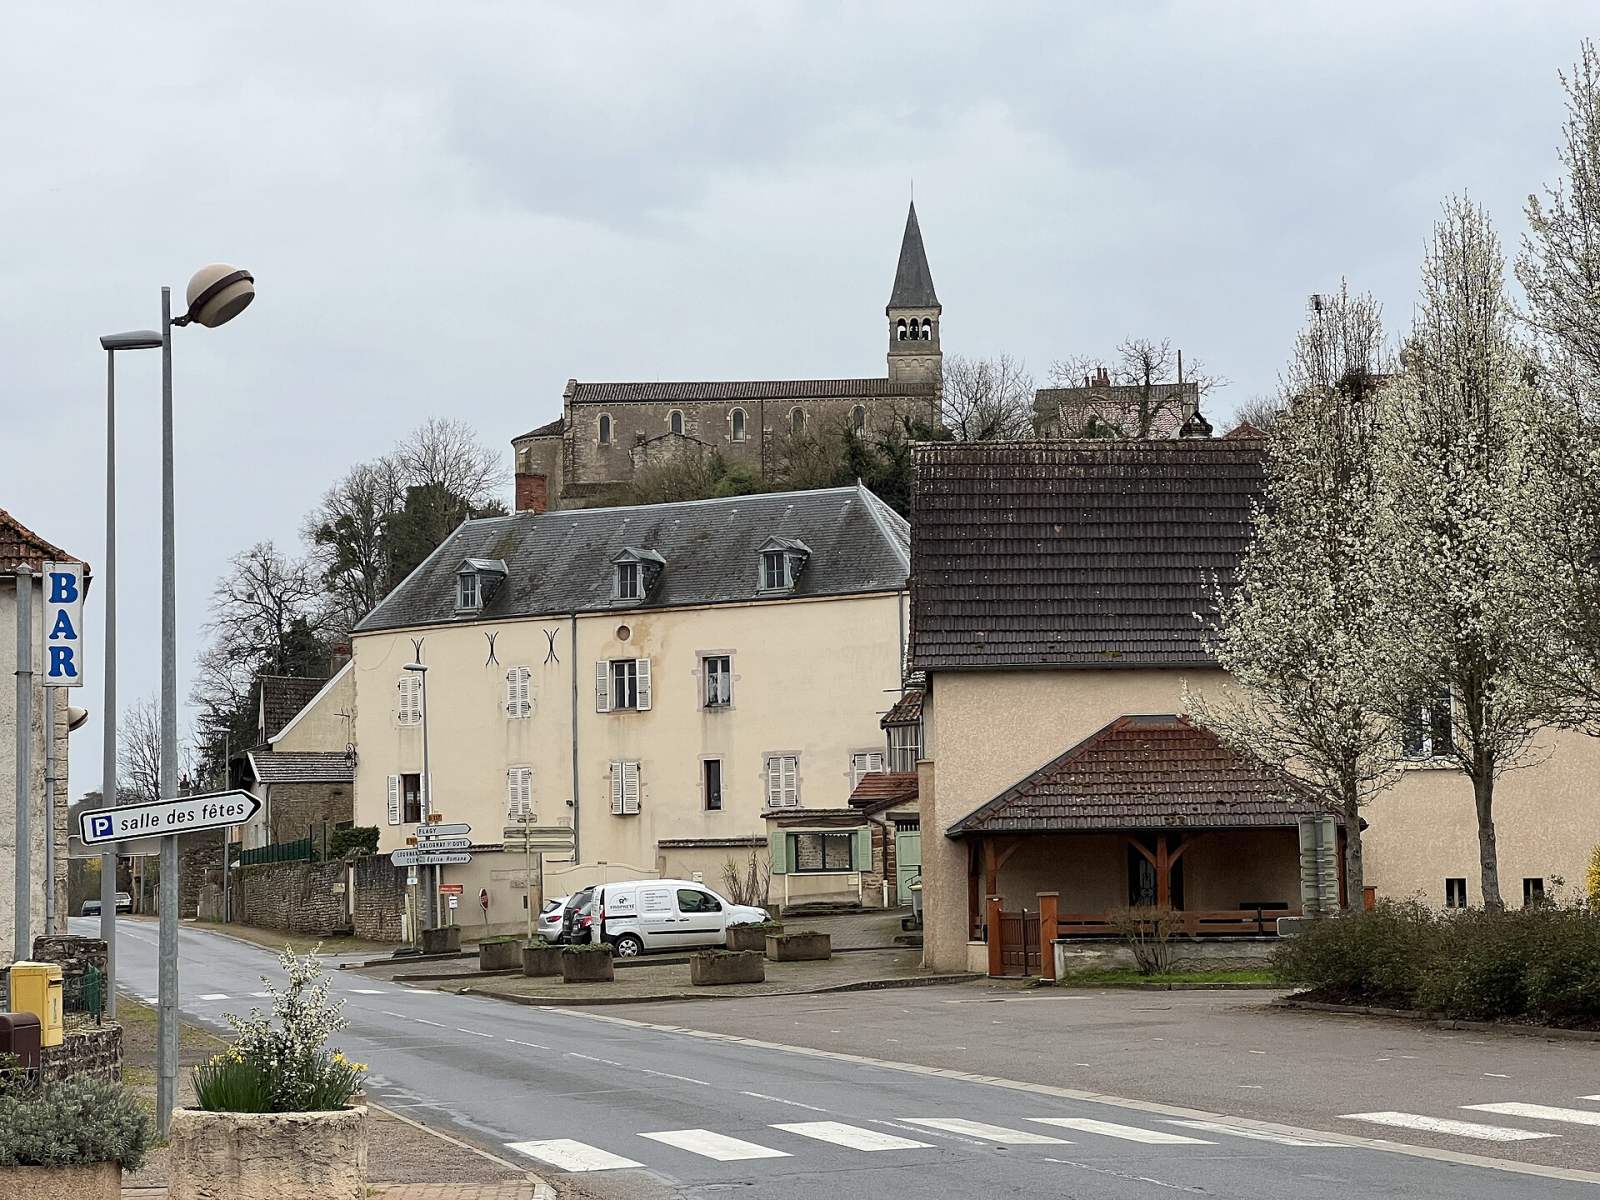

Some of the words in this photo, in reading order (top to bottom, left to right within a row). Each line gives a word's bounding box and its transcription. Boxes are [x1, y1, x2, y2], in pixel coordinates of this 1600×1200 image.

[48, 573, 78, 677] BAR
[121, 813, 160, 831] salle
[167, 809, 195, 825] des
[202, 802, 244, 820] fêtes
